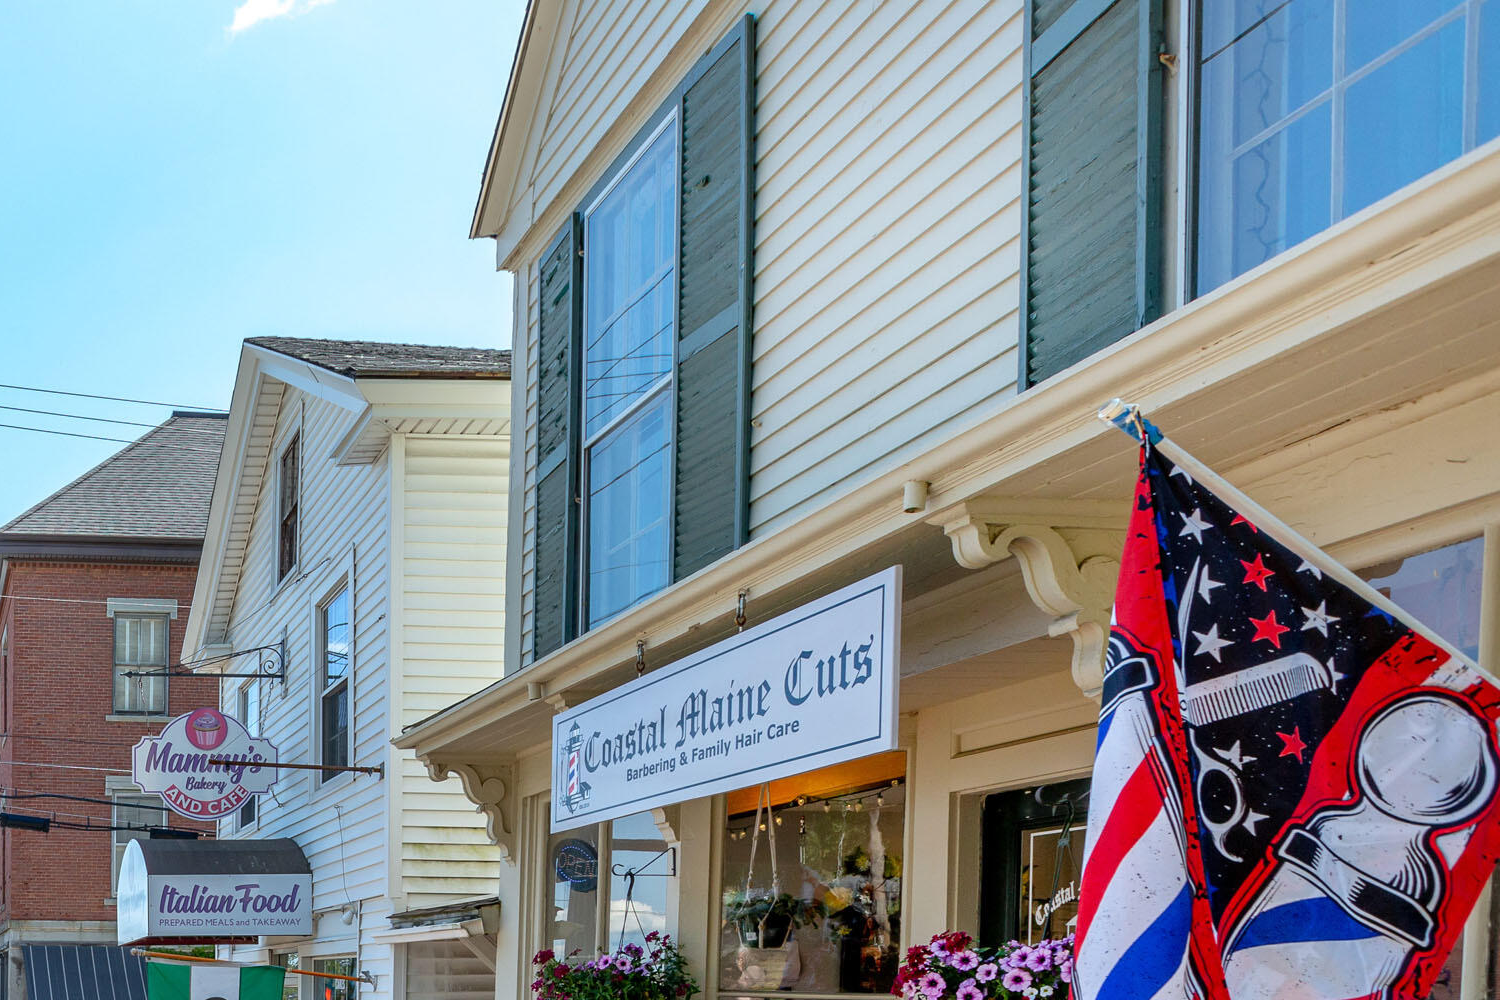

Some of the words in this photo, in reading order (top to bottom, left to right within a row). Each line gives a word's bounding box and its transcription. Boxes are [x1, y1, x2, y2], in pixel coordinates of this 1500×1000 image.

[584, 704, 669, 773] Coastal
[675, 679, 772, 751] Maine
[783, 634, 875, 707] Cuts
[145, 742, 268, 785] Mammy's
[626, 755, 676, 782] Barbering
[679, 753, 688, 766] &
[691, 740, 732, 764] Family
[735, 728, 762, 750] Hair
[767, 719, 800, 740] Care
[165, 787, 202, 813] AND
[208, 786, 248, 814] CAFE
[185, 776, 228, 795] Bakery
[159, 884, 238, 914] Italian
[234, 883, 301, 914] Food
[159, 919, 204, 927] PREPARED
[205, 918, 234, 926] MEALS
[235, 918, 250, 926] and
[252, 918, 301, 926] TAKEAWAY
